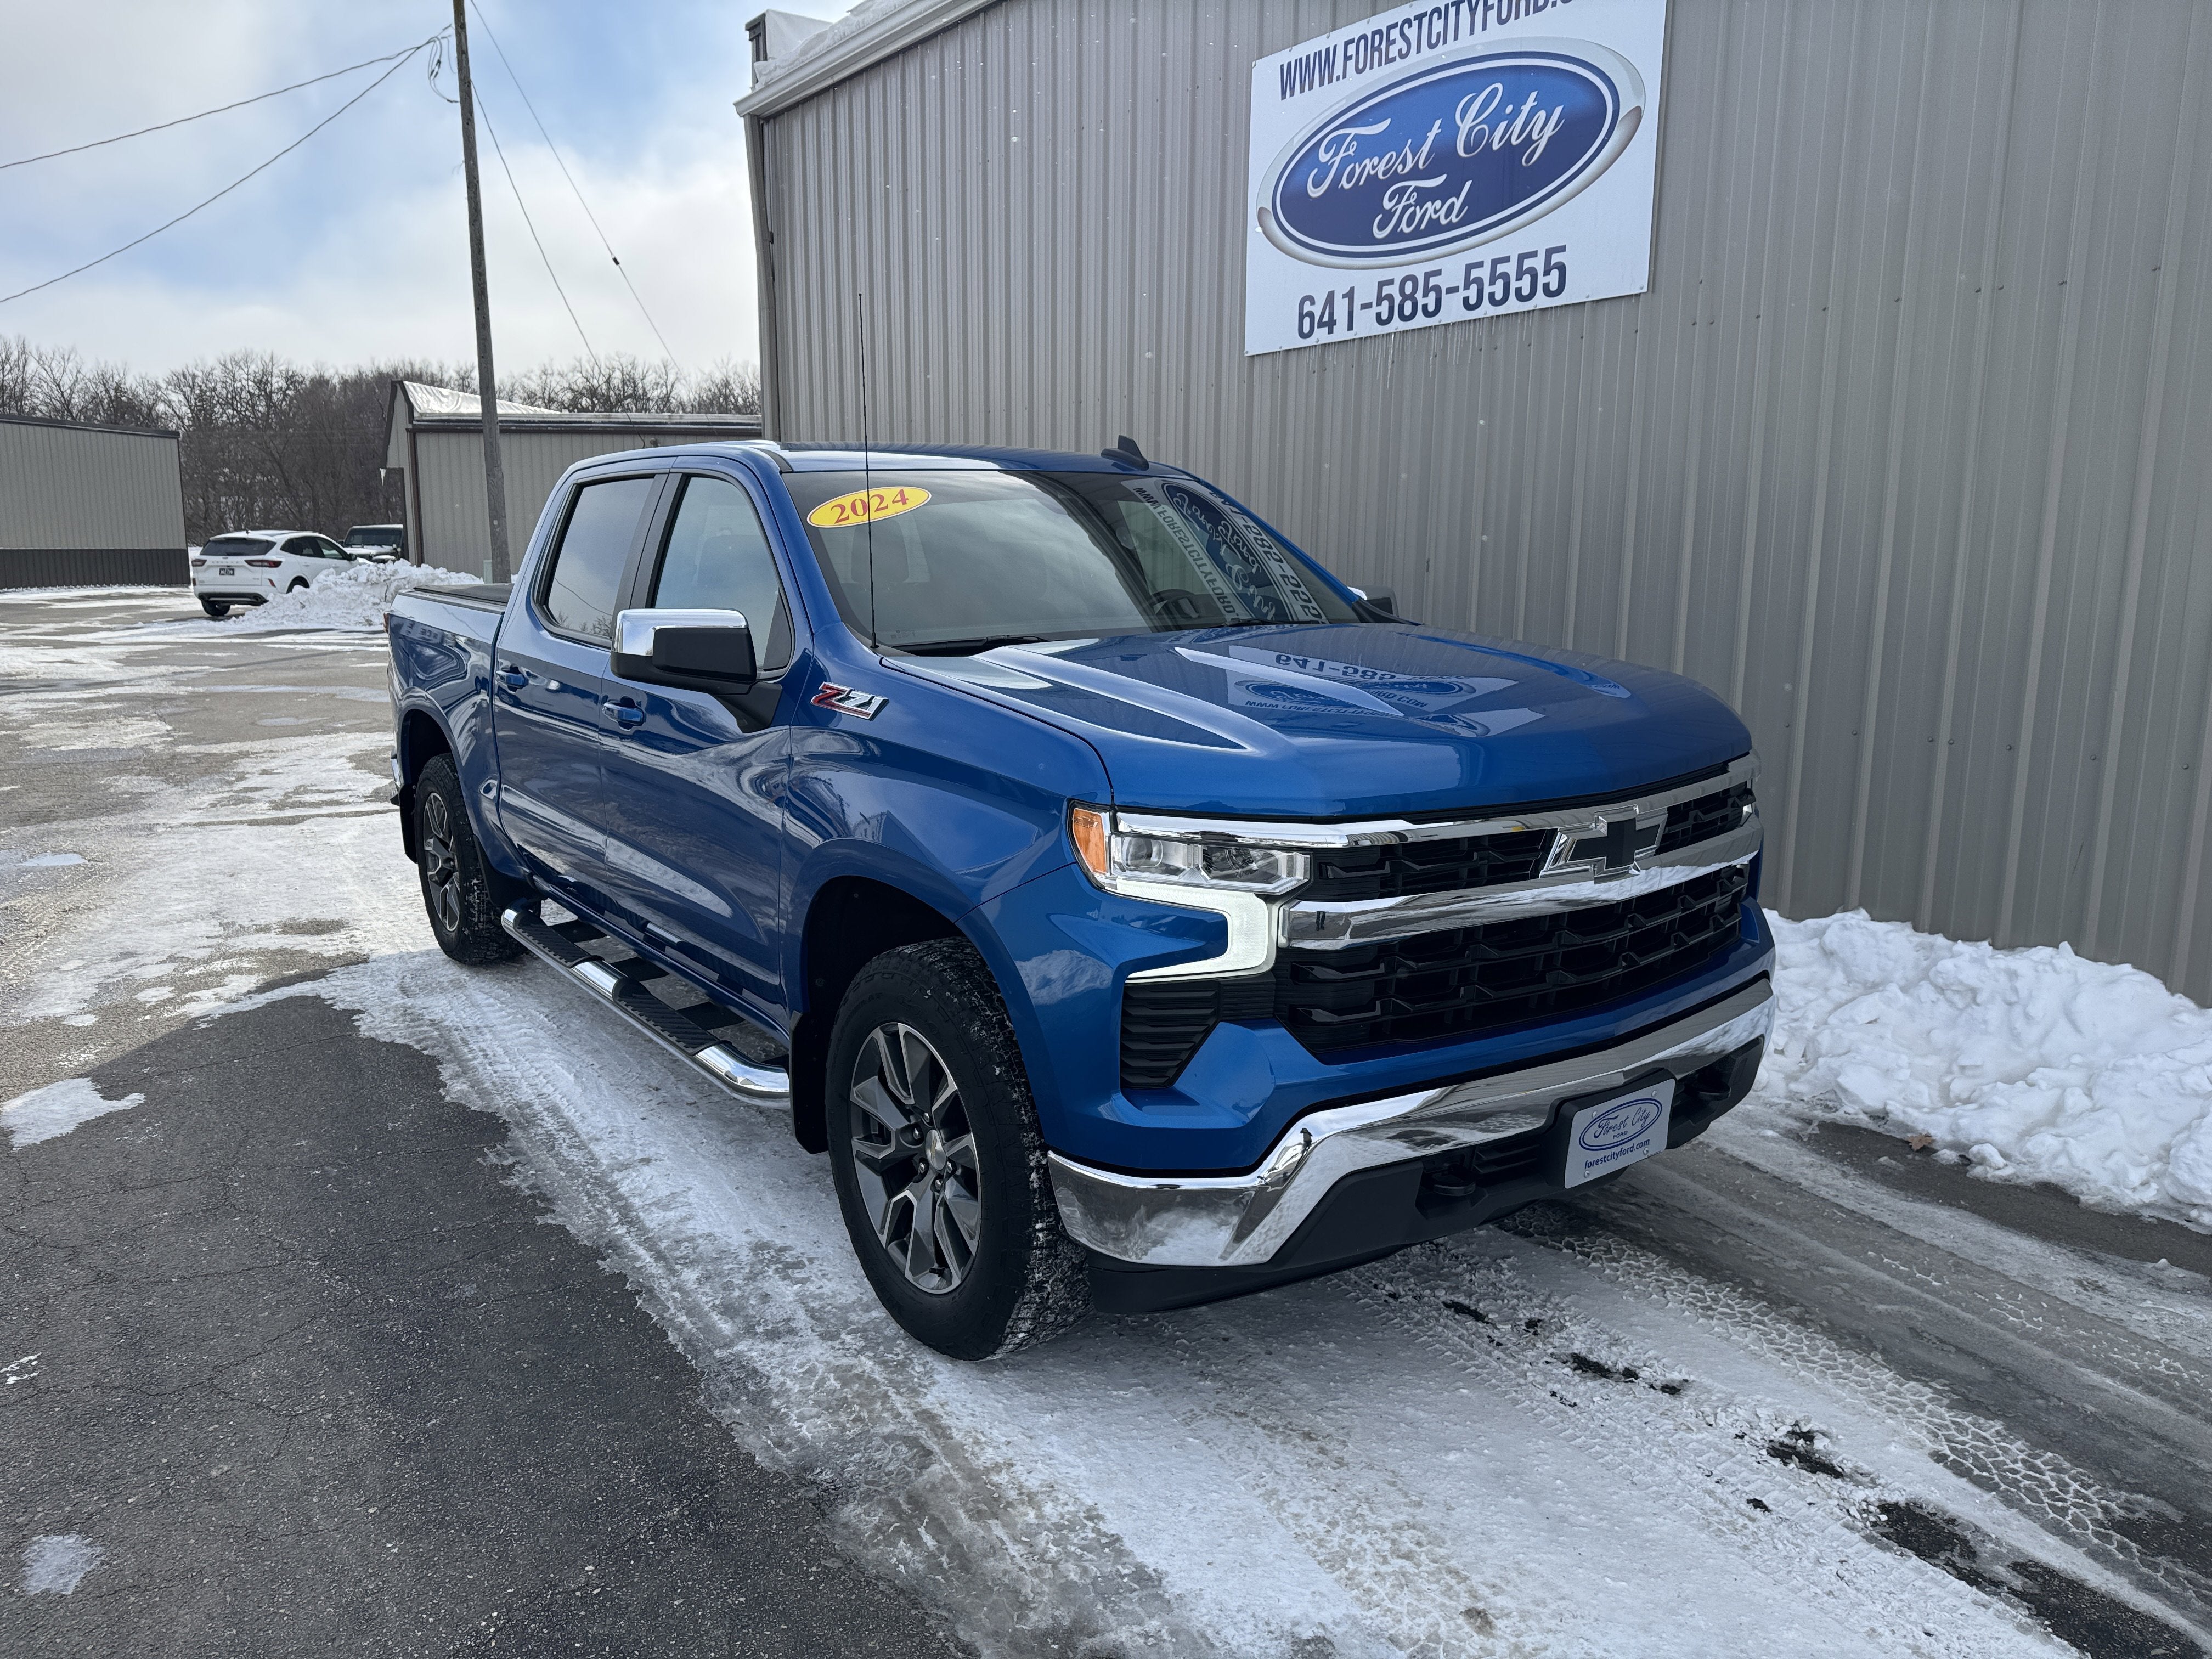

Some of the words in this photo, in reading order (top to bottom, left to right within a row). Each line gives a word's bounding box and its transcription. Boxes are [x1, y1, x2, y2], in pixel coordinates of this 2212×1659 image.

[1280, 0, 1573, 100] WWW.FORESTCITYFO.
[1306, 117, 1442, 198] Forest
[1455, 82, 1565, 167] City
[1372, 173, 1473, 239] Ford
[1297, 245, 1567, 340] 641-585-5555
[830, 488, 910, 524] 2024
[810, 681, 889, 721] Z71
[1594, 1114, 1629, 1138] Forest
[1631, 1107, 1651, 1128] City
[1612, 1130, 1628, 1139] FORD
[1584, 1138, 1650, 1169] forestcityford.com
